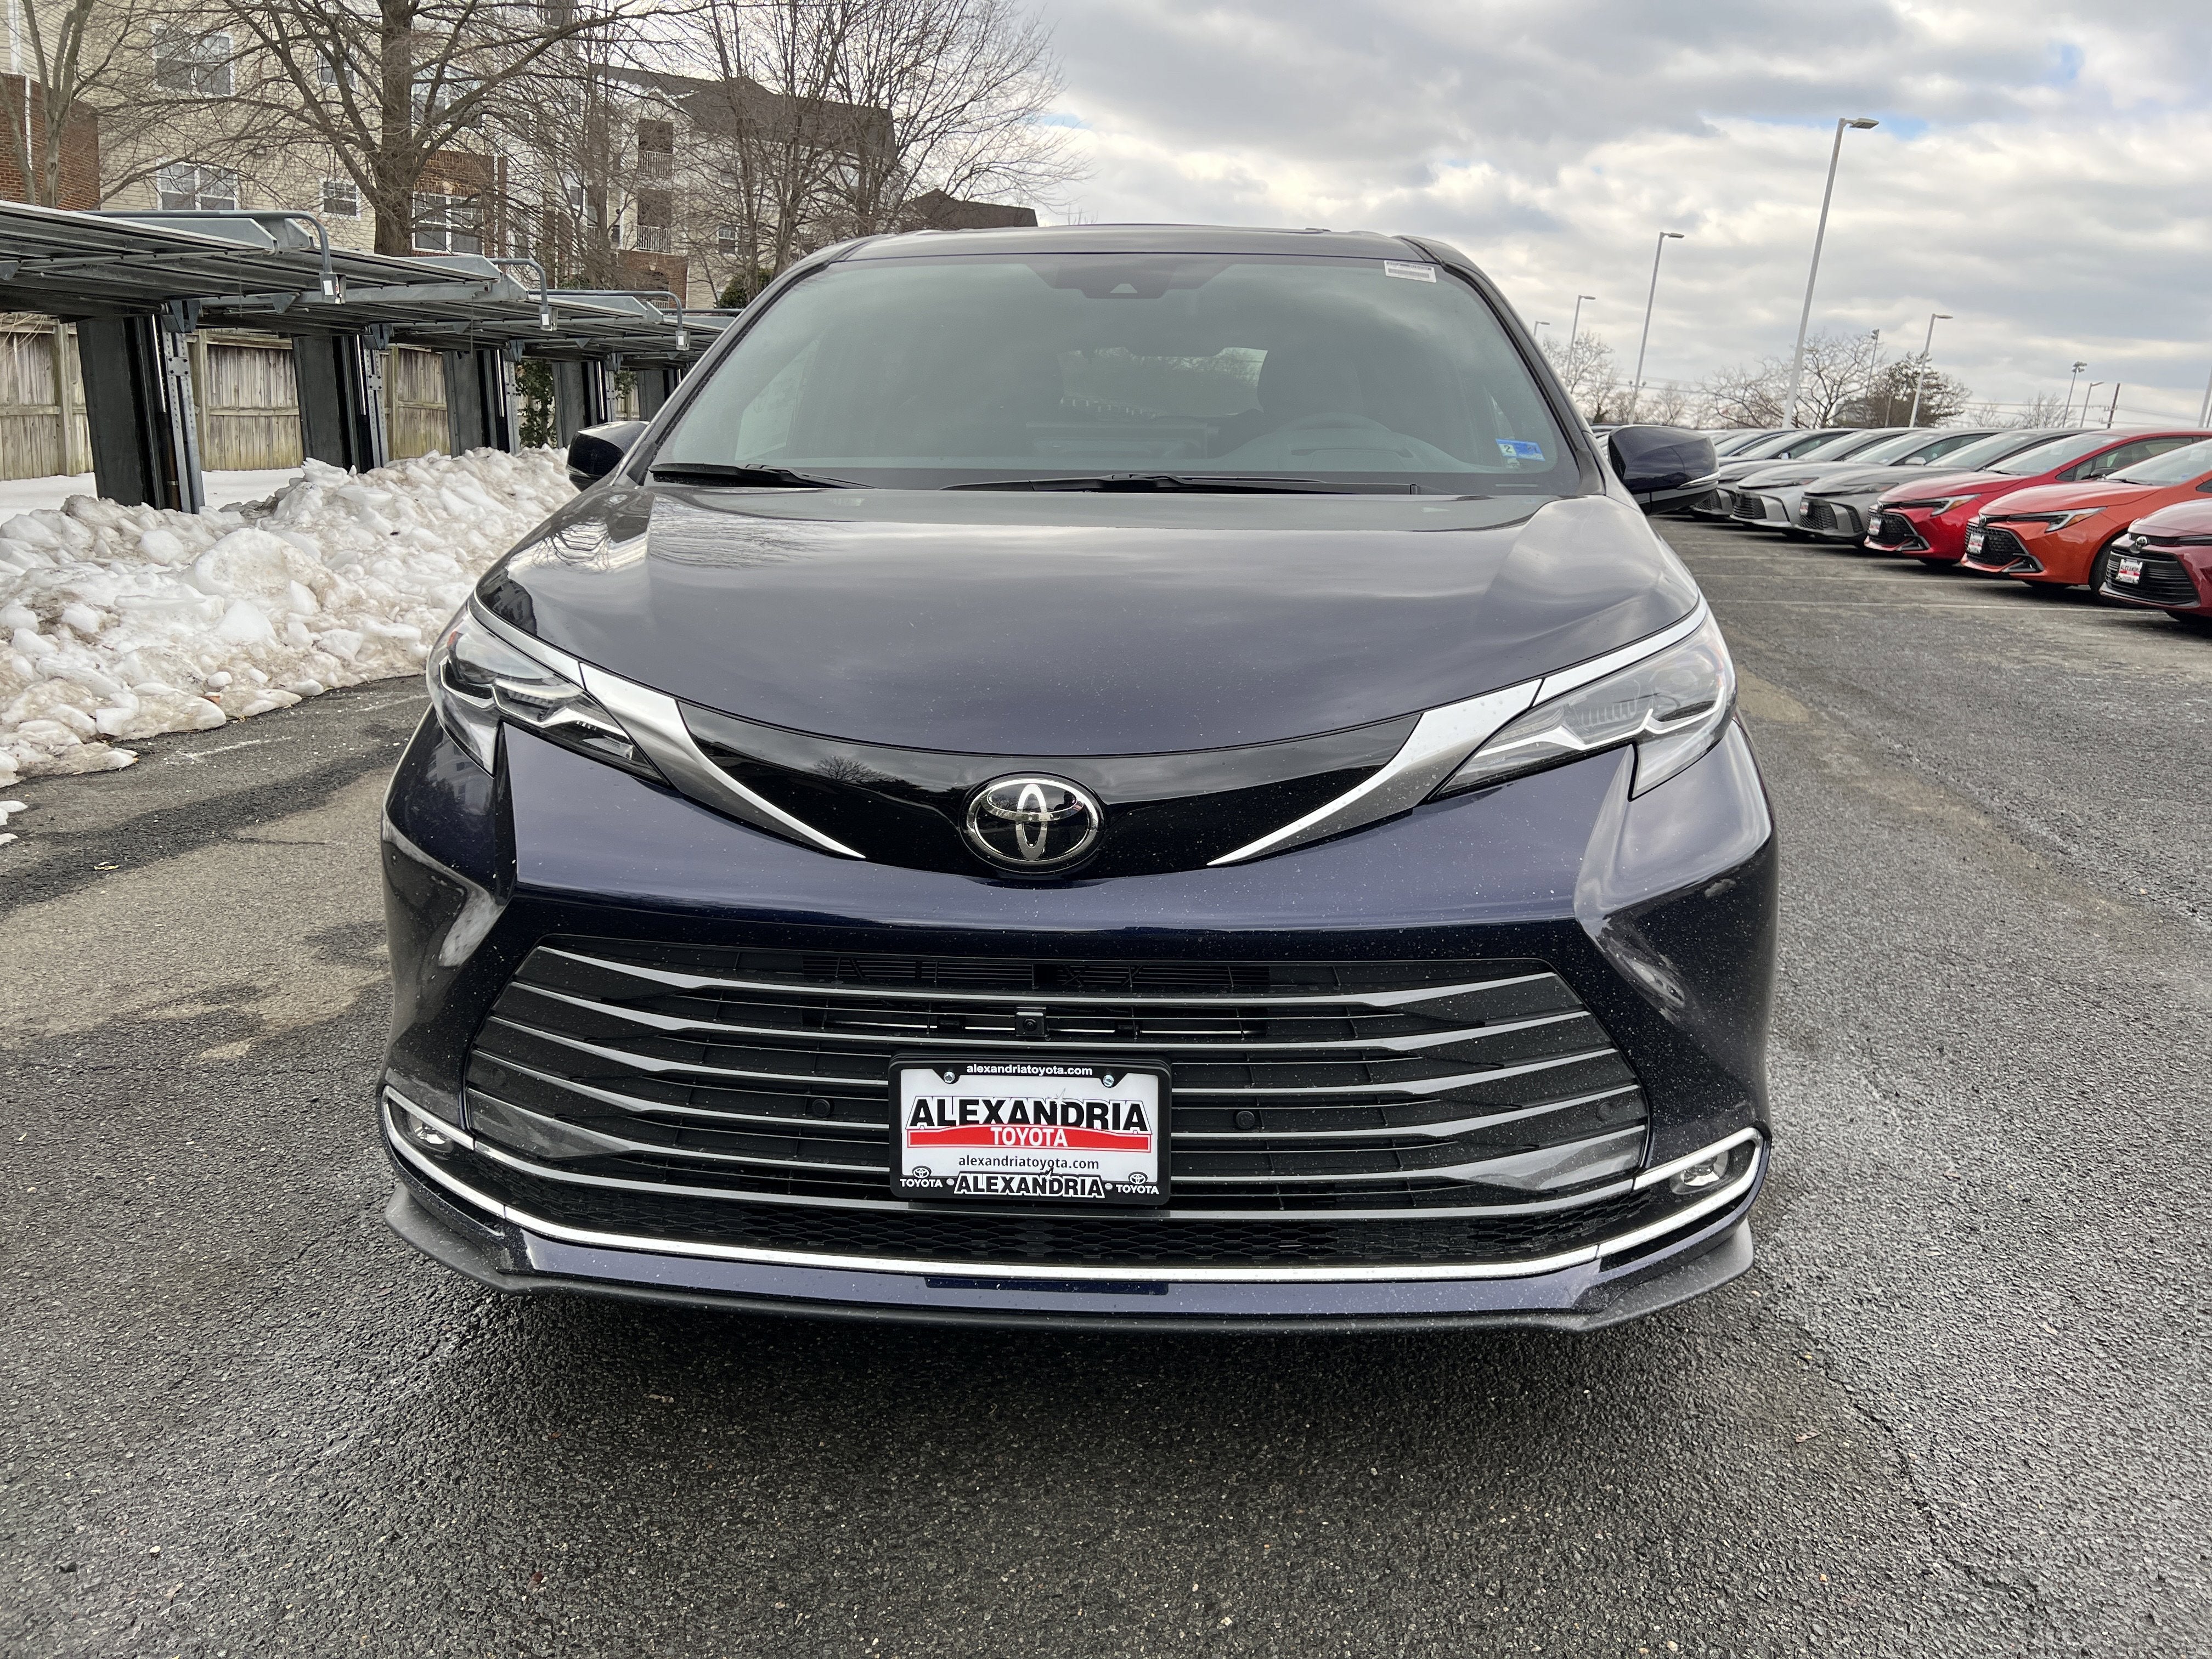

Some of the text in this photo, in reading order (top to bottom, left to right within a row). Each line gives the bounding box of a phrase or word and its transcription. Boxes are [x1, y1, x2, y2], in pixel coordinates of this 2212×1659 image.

[1503, 445, 1513, 453] 2
[966, 1064, 1093, 1076] alexandriatoyota.com
[909, 1098, 1149, 1131] ALEXANDRIA
[990, 1126, 1068, 1147] TOYOTA
[958, 1154, 1099, 1170] alexandriatoyota.com
[899, 1172, 1159, 1198] TOYOTA ALEXANDRIA TOYOTA
